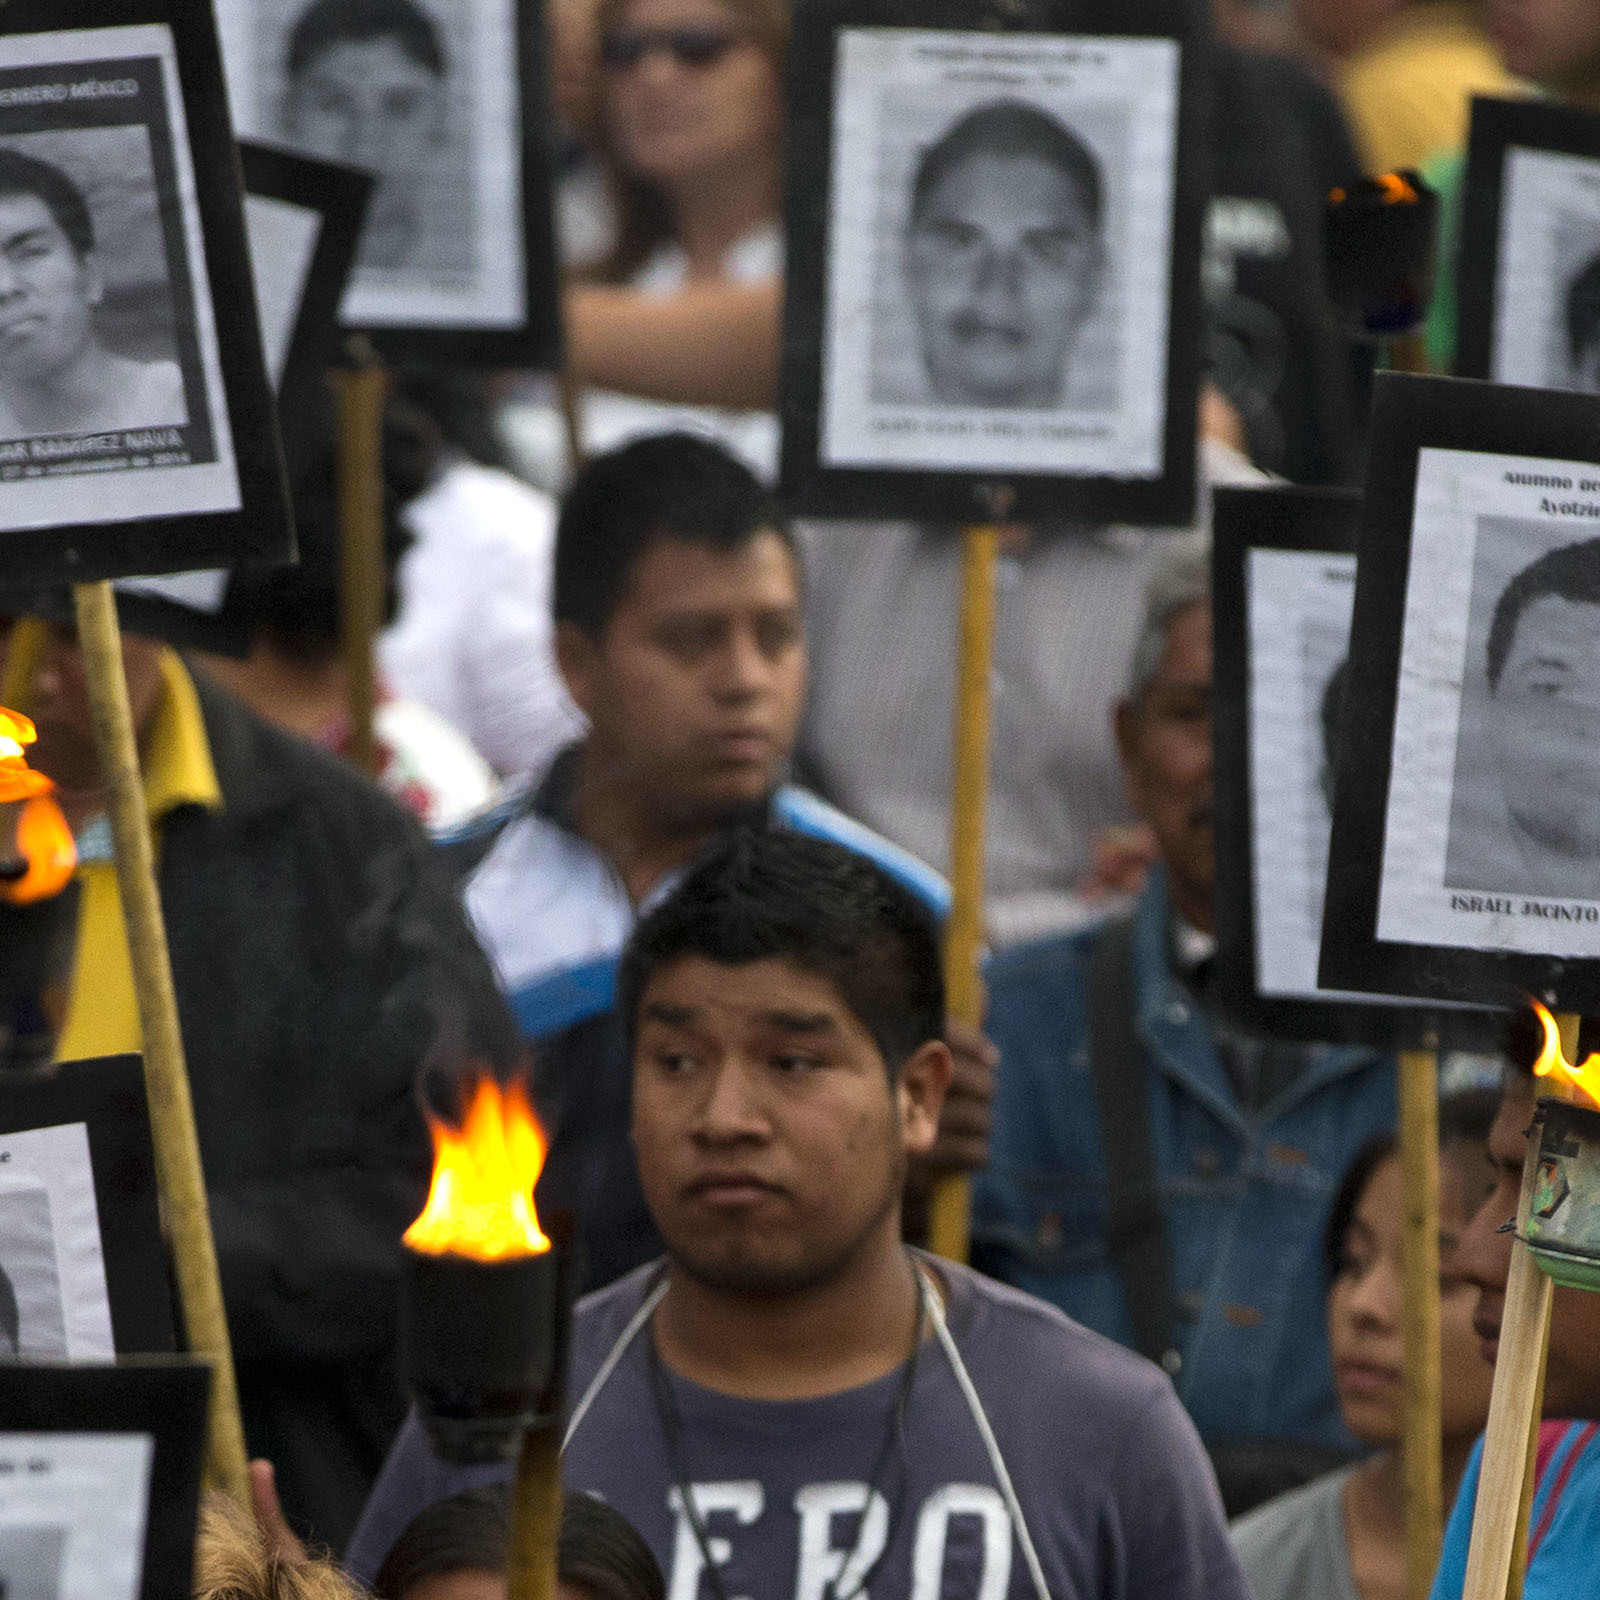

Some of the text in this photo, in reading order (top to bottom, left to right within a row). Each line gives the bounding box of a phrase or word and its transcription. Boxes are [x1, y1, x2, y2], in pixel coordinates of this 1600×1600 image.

[1504, 471, 1573, 490] Alumno
[1450, 893, 1514, 915] ISRAEL
[1521, 900, 1599, 924] JACINTO
